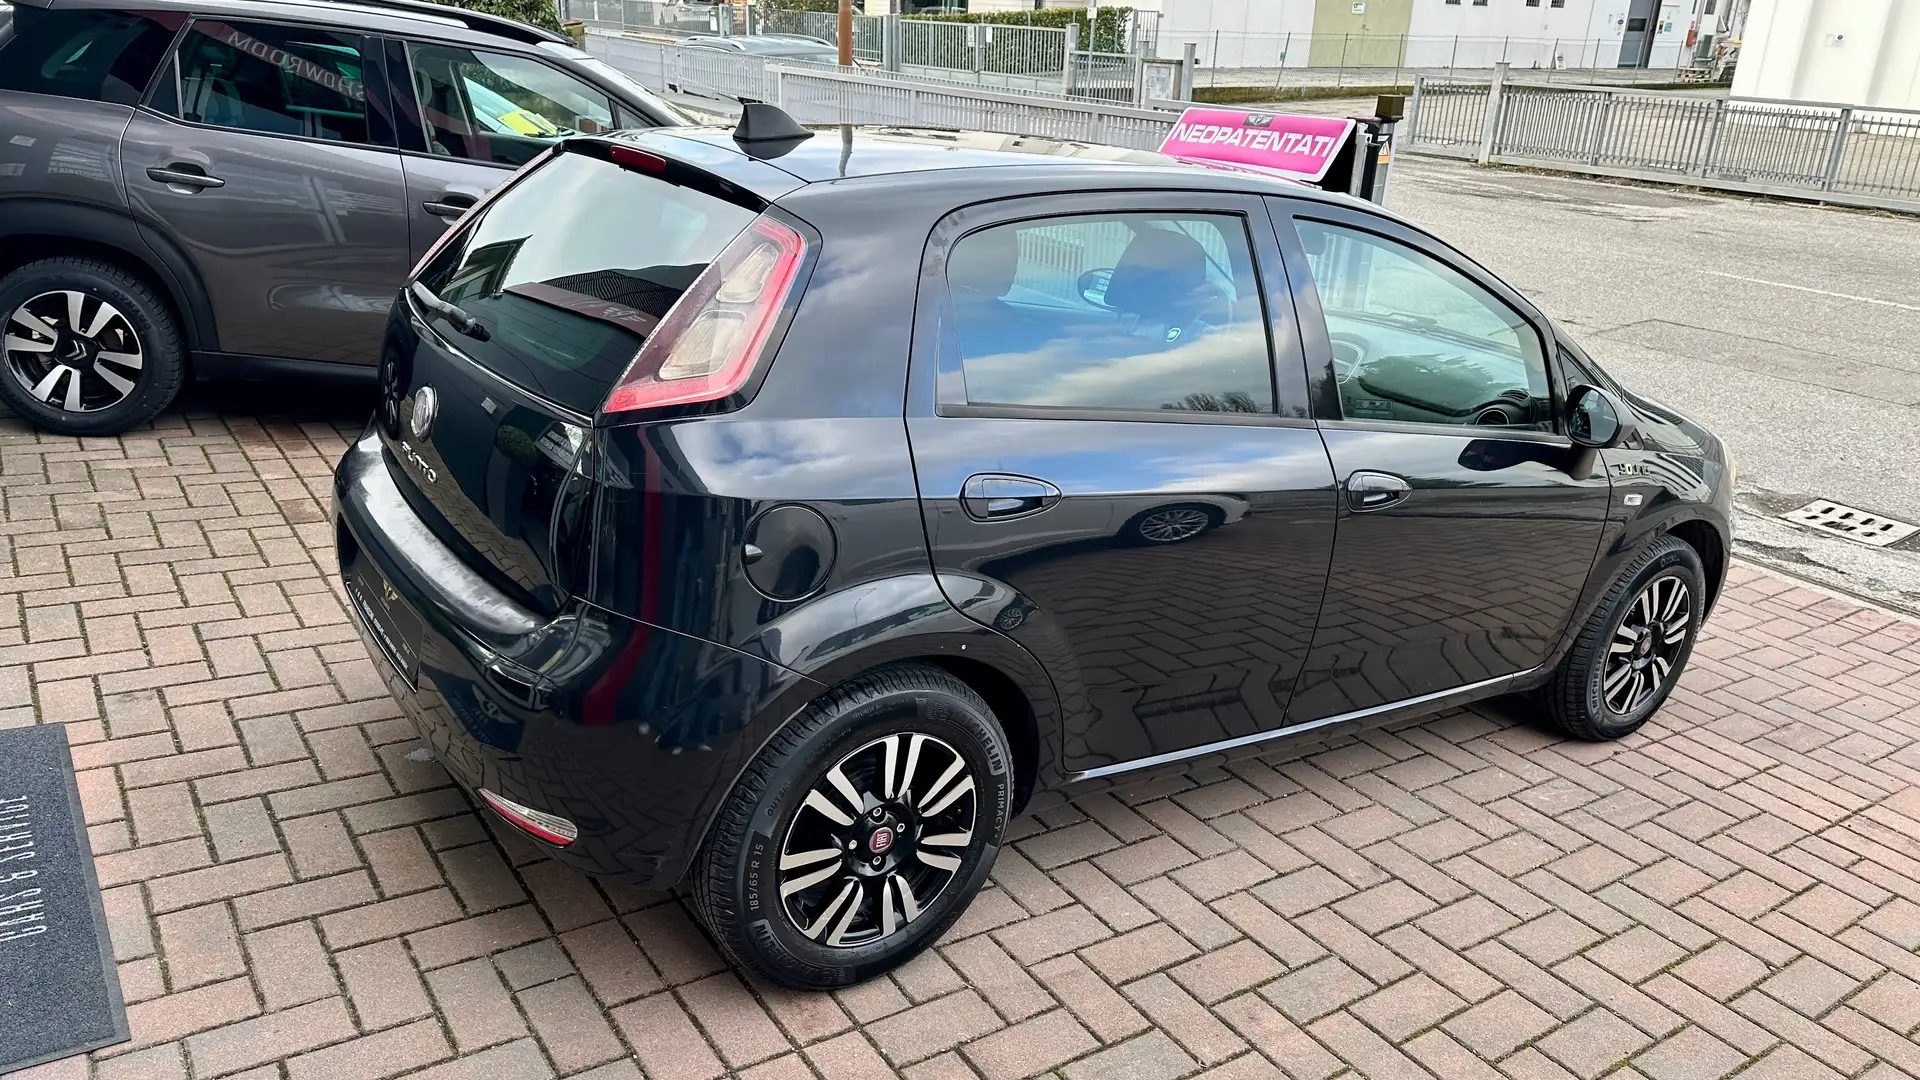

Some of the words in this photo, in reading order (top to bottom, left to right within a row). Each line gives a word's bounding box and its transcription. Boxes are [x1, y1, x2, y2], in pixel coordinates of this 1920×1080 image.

[1171, 123, 1336, 157] NEOPATENTATI
[994, 783, 1005, 831] PRIMACY
[751, 860, 760, 869] R
[753, 843, 764, 855] 15
[749, 872, 760, 911] 185/65
